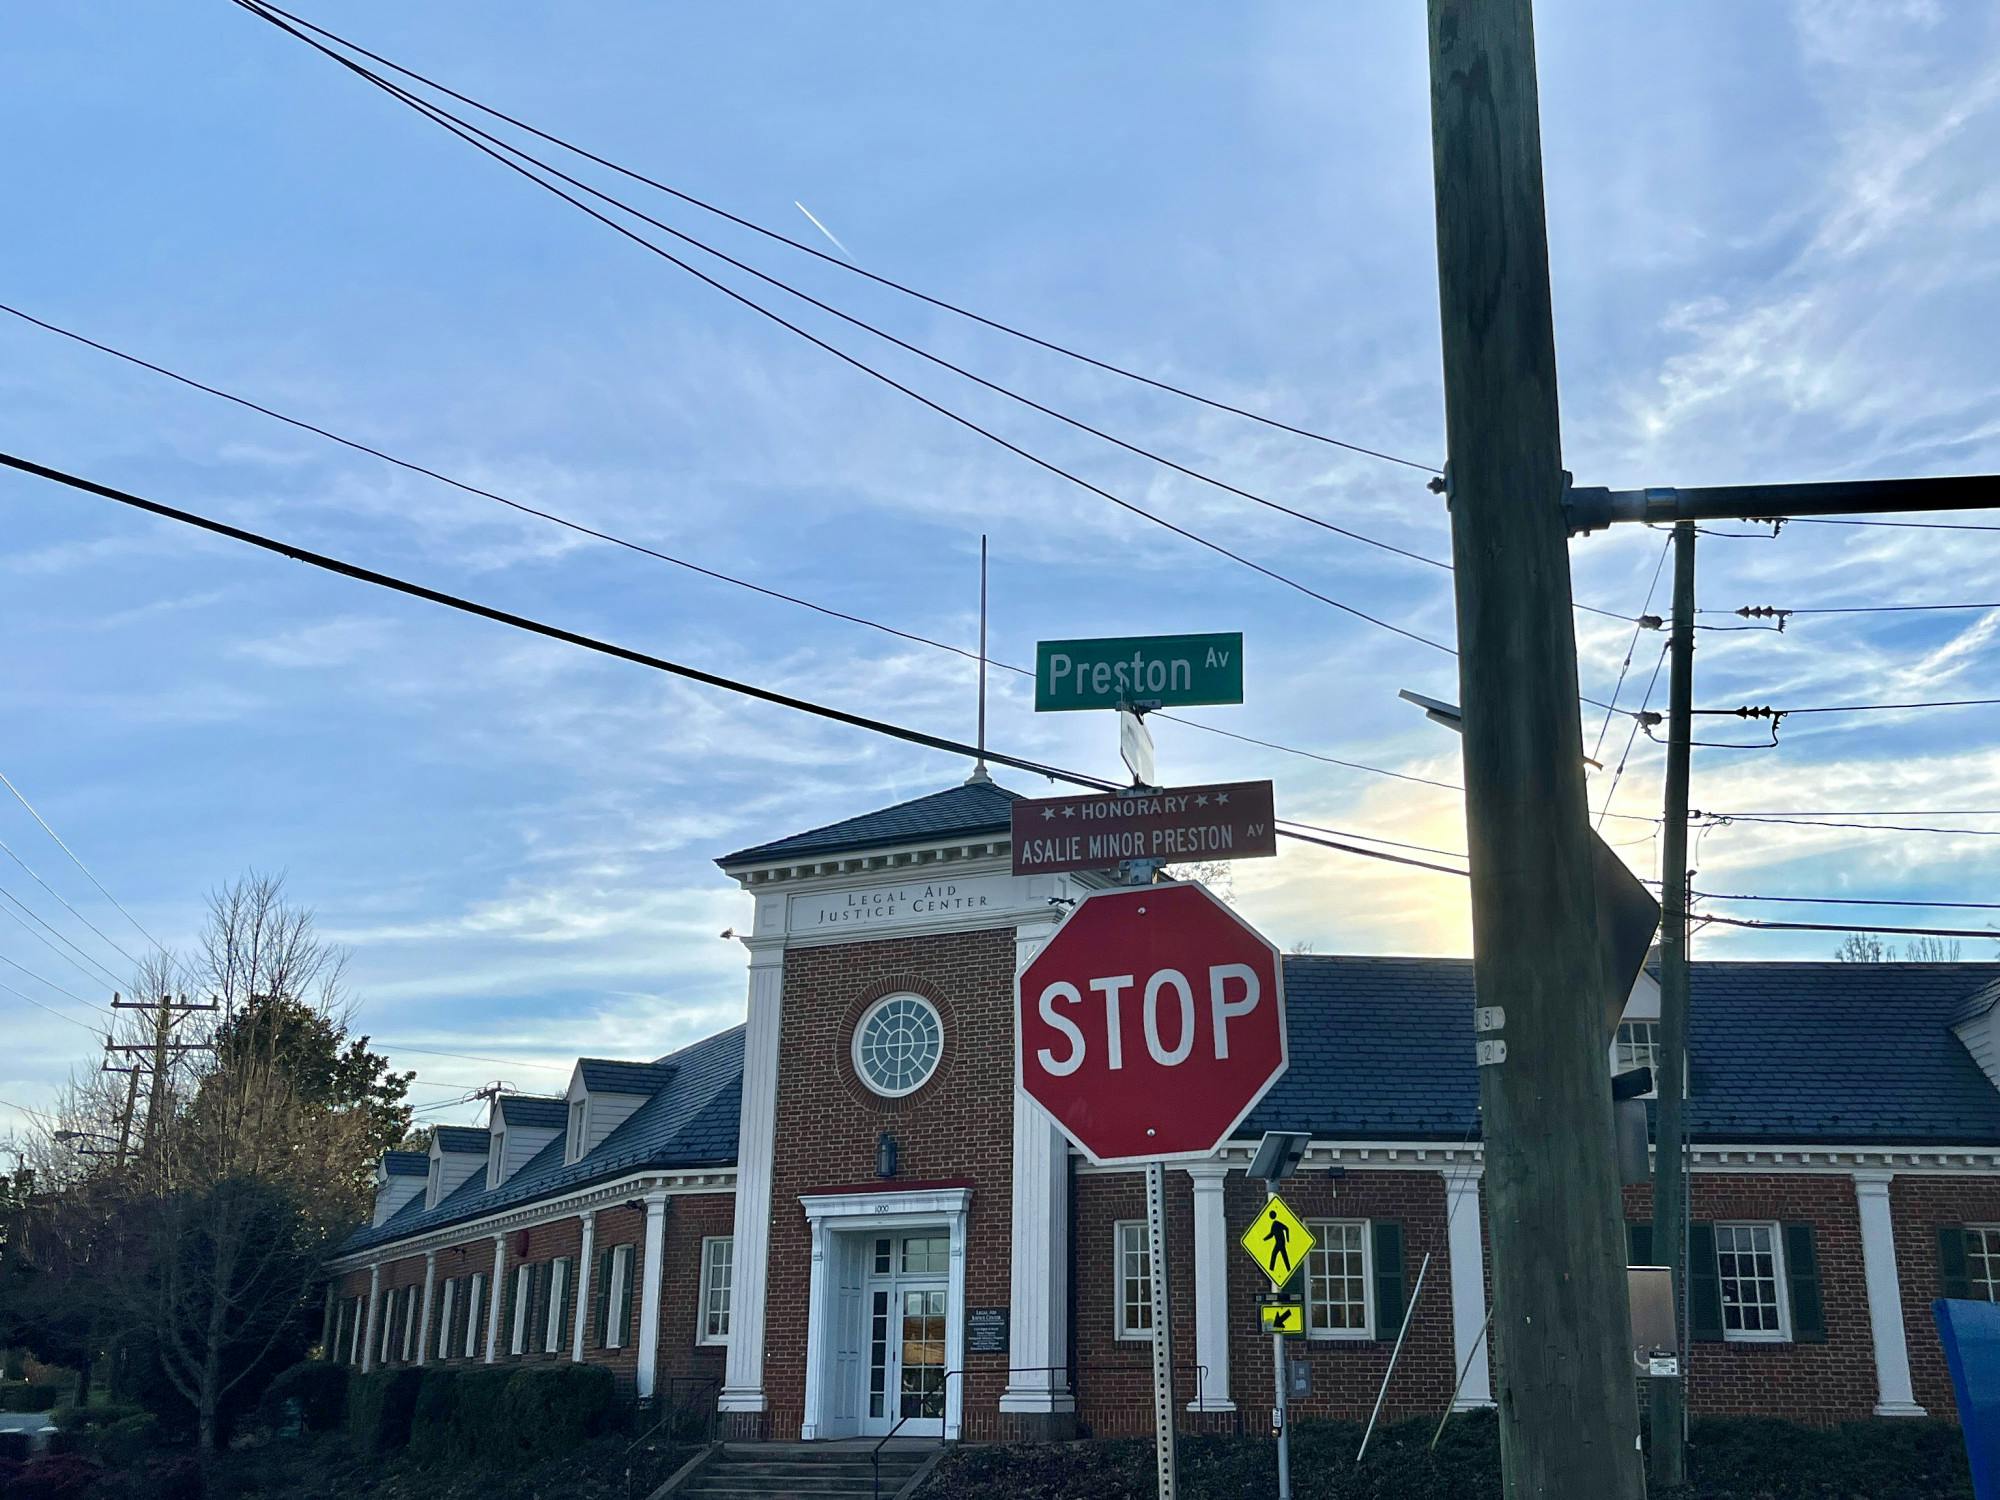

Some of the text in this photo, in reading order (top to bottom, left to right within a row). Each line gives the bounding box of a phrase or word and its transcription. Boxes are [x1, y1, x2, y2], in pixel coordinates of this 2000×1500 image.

[1050, 647, 1229, 695] Preston Av
[1082, 797, 1188, 820] HONORARY
[1021, 823, 1264, 864] ASALIE MINOR PRESTON AV
[818, 896, 988, 924] JUSTICE CENTER
[848, 885, 956, 906] LEGAL AID
[1037, 963, 1261, 1077] STOP
